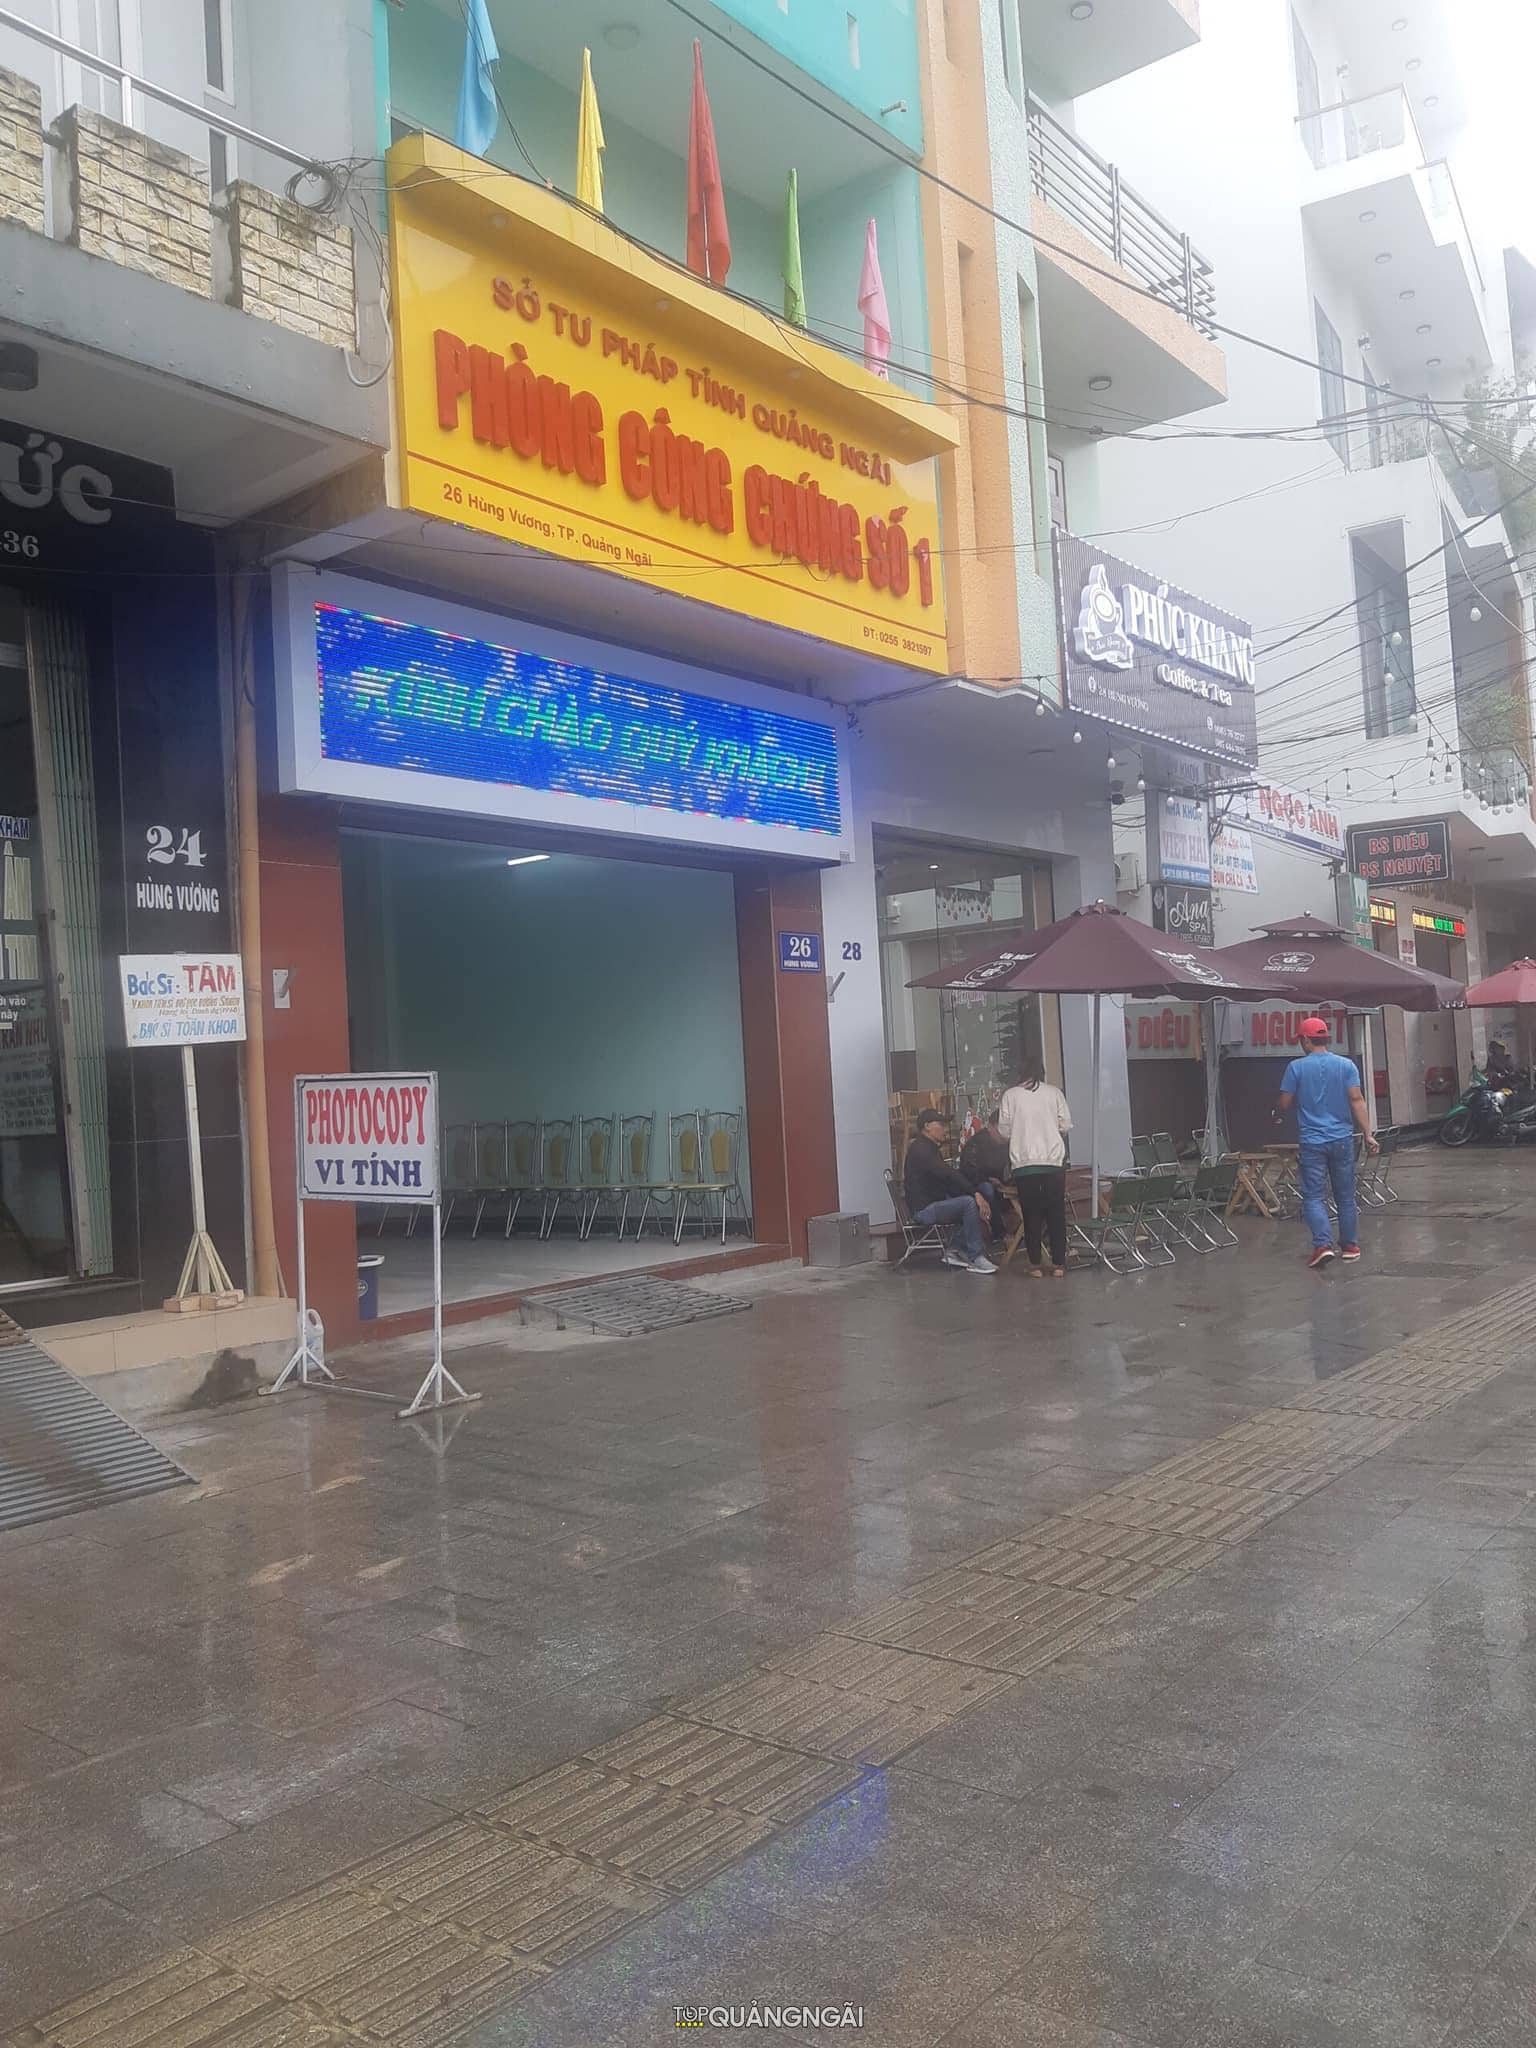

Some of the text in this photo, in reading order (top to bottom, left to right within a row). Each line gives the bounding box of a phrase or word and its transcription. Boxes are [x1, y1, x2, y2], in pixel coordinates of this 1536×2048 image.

[492, 277, 541, 322] SỞ
[602, 331, 678, 384] PHÁP
[686, 367, 746, 420] TỈNH
[752, 403, 834, 460] QUẢNG
[840, 442, 892, 487] NGÃI
[433, 328, 933, 608] PHÒNG CÔNG CHỨNG SỐ 1
[443, 482, 463, 505] 26
[468, 493, 505, 522] Hùng
[582, 532, 622, 559] Quảng
[625, 546, 652, 567] Ngãi
[1122, 584, 1256, 685] PHÚC KHANG
[1156, 663, 1232, 706] Coffee & Tea
[146, 825, 207, 867] 24
[1359, 851, 1442, 878] BS NGUYỆT
[1369, 837, 1389, 855] BS
[136, 876, 220, 913] HÙNG VƯƠNG
[1189, 921, 1207, 933] SPA
[789, 937, 812, 958] 26
[842, 941, 862, 961] 28
[207, 1019, 238, 1035] KHOA
[1252, 1003, 1345, 1046] NGUT
[306, 1086, 428, 1145] PHOTOCOPY
[315, 1152, 422, 1187] VI TÍNH
